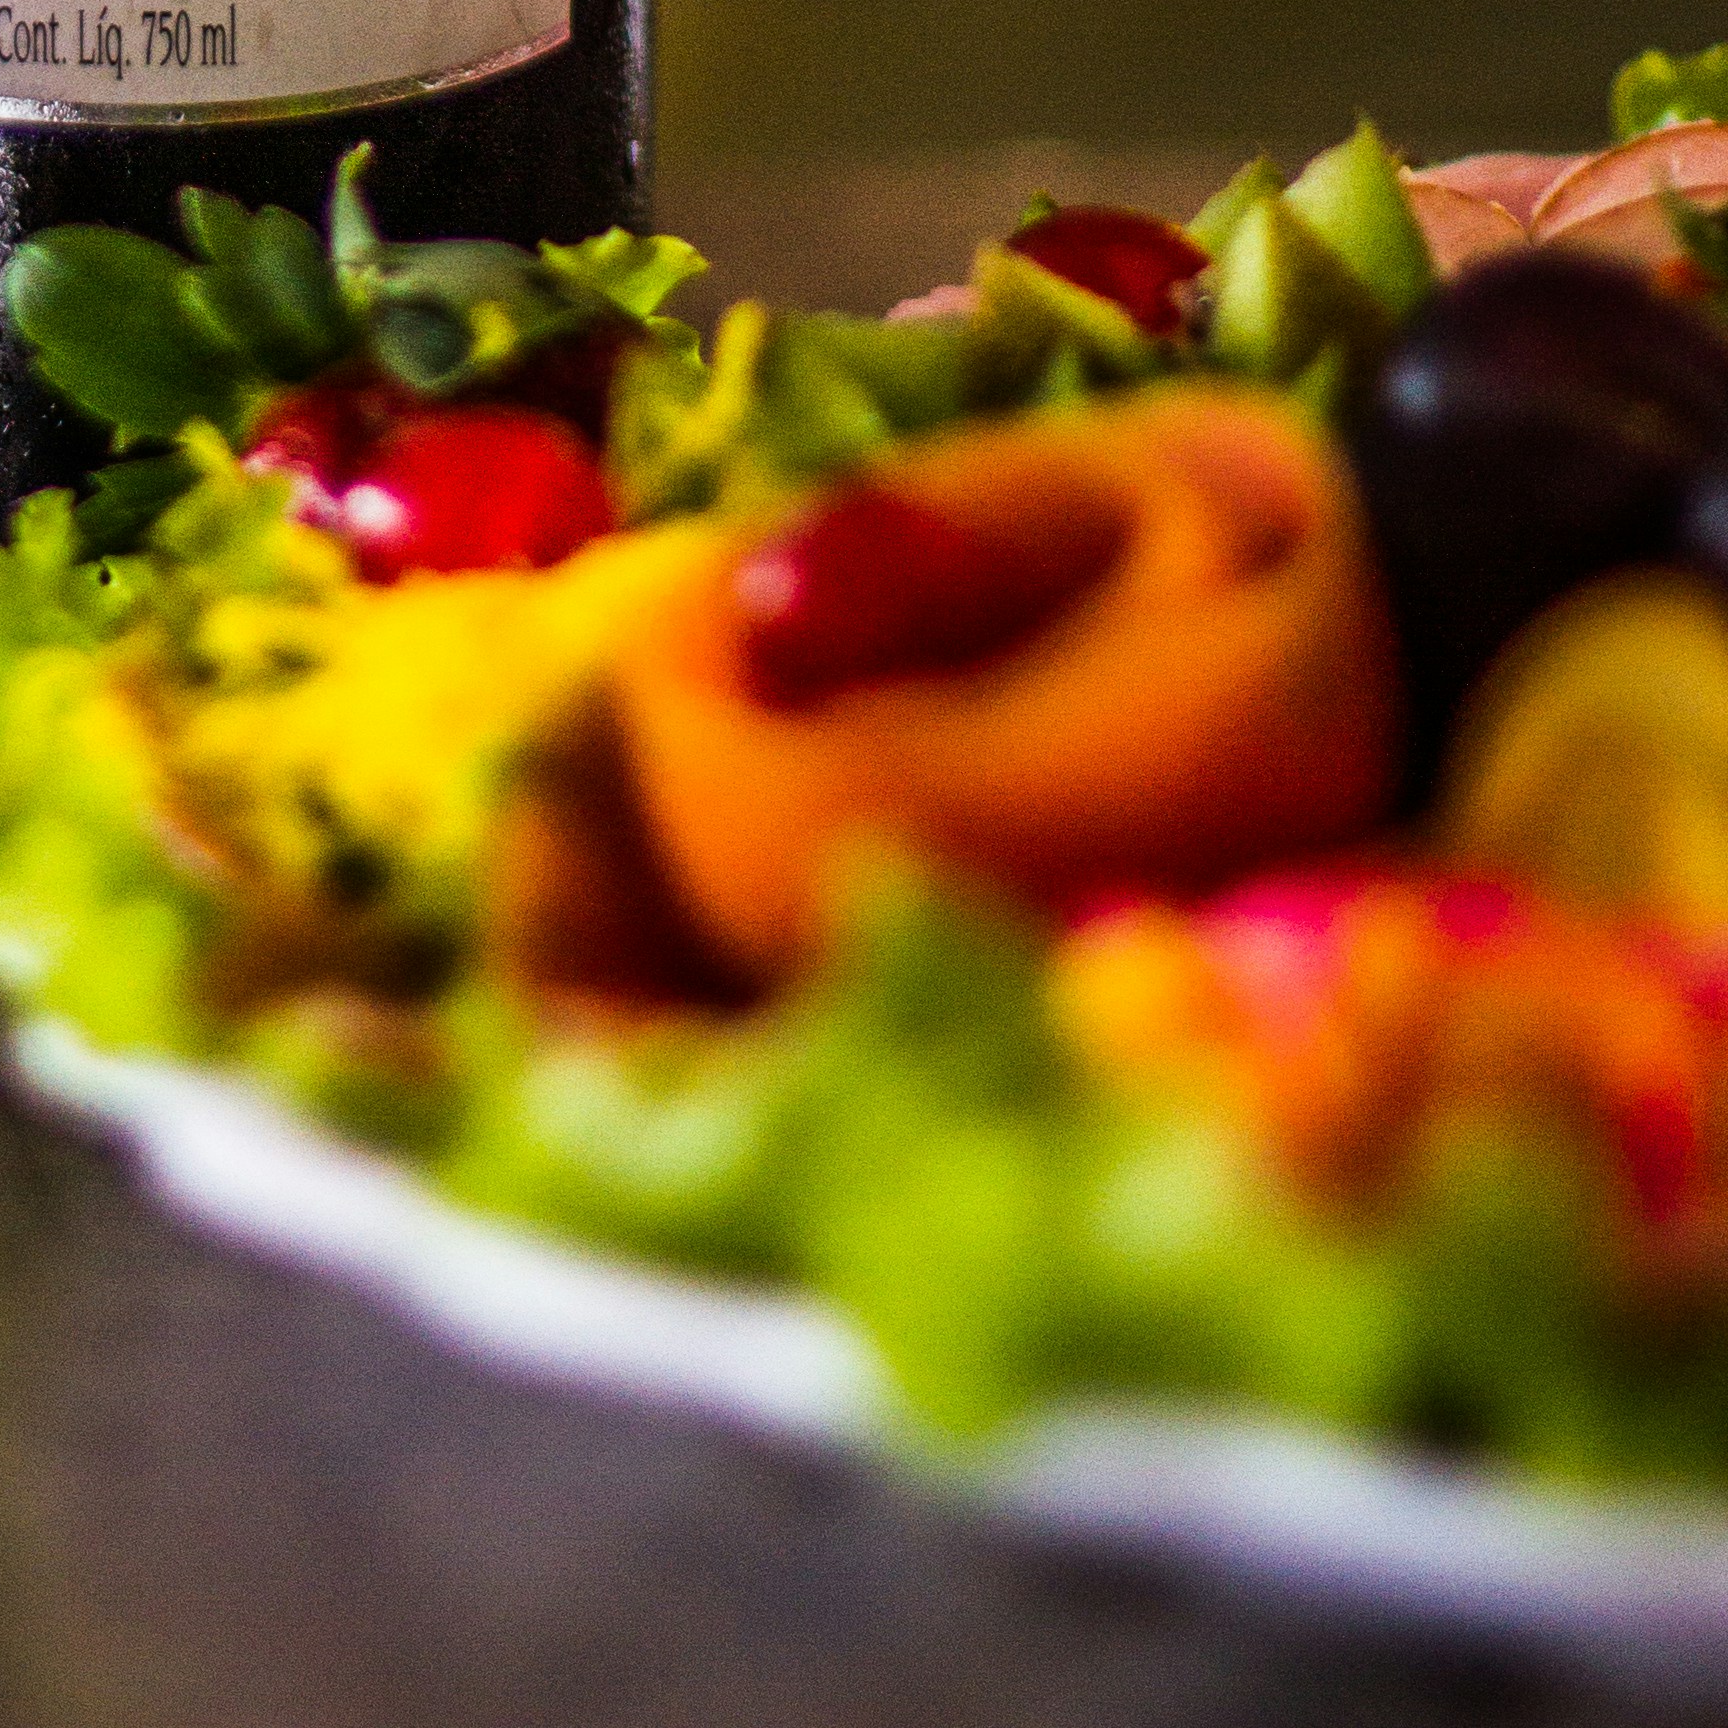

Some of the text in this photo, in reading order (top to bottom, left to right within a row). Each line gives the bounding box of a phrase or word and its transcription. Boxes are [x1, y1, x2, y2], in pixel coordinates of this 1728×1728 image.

[77, 5, 131, 80] Líq.
[141, 9, 191, 67] 750
[200, 3, 238, 66] ml
